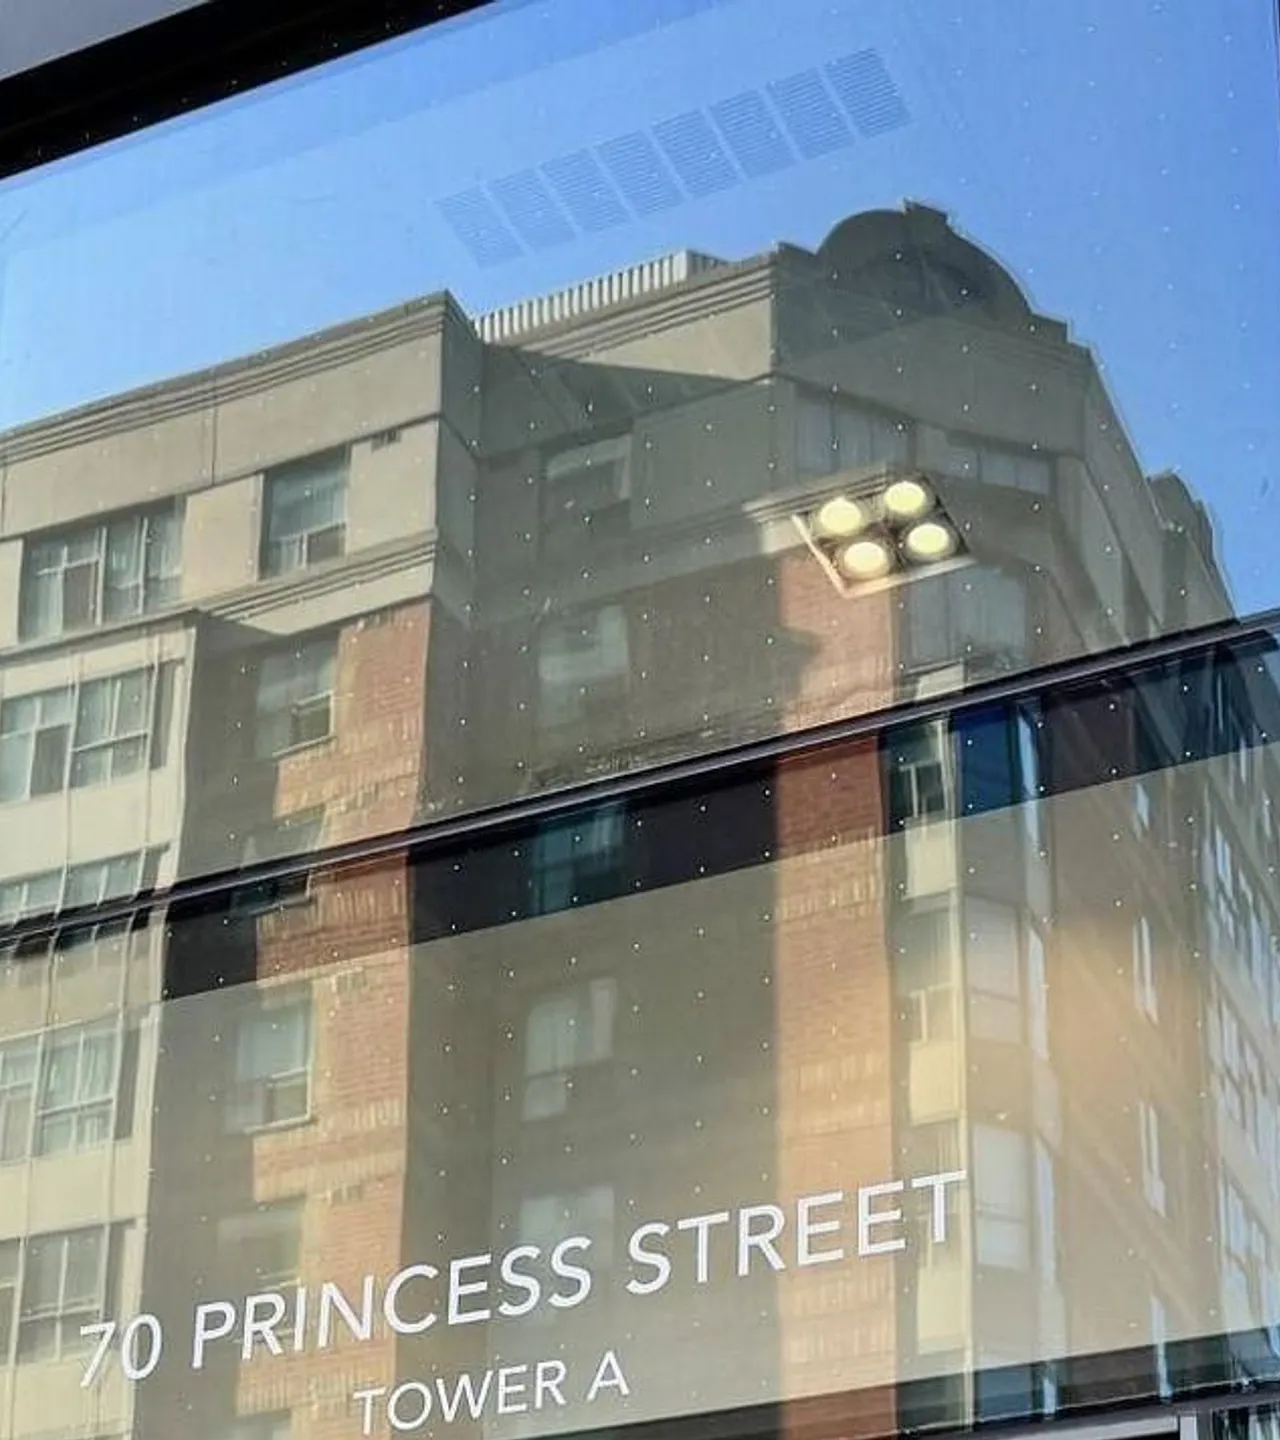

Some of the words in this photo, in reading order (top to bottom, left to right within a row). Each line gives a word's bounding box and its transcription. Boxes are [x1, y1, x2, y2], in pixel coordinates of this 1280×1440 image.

[78, 1312, 164, 1390] 70
[190, 1235, 594, 1371] PRINCESS
[626, 1169, 968, 1296] STREET
[352, 1357, 567, 1437] TOWER
[588, 1350, 631, 1398] A
